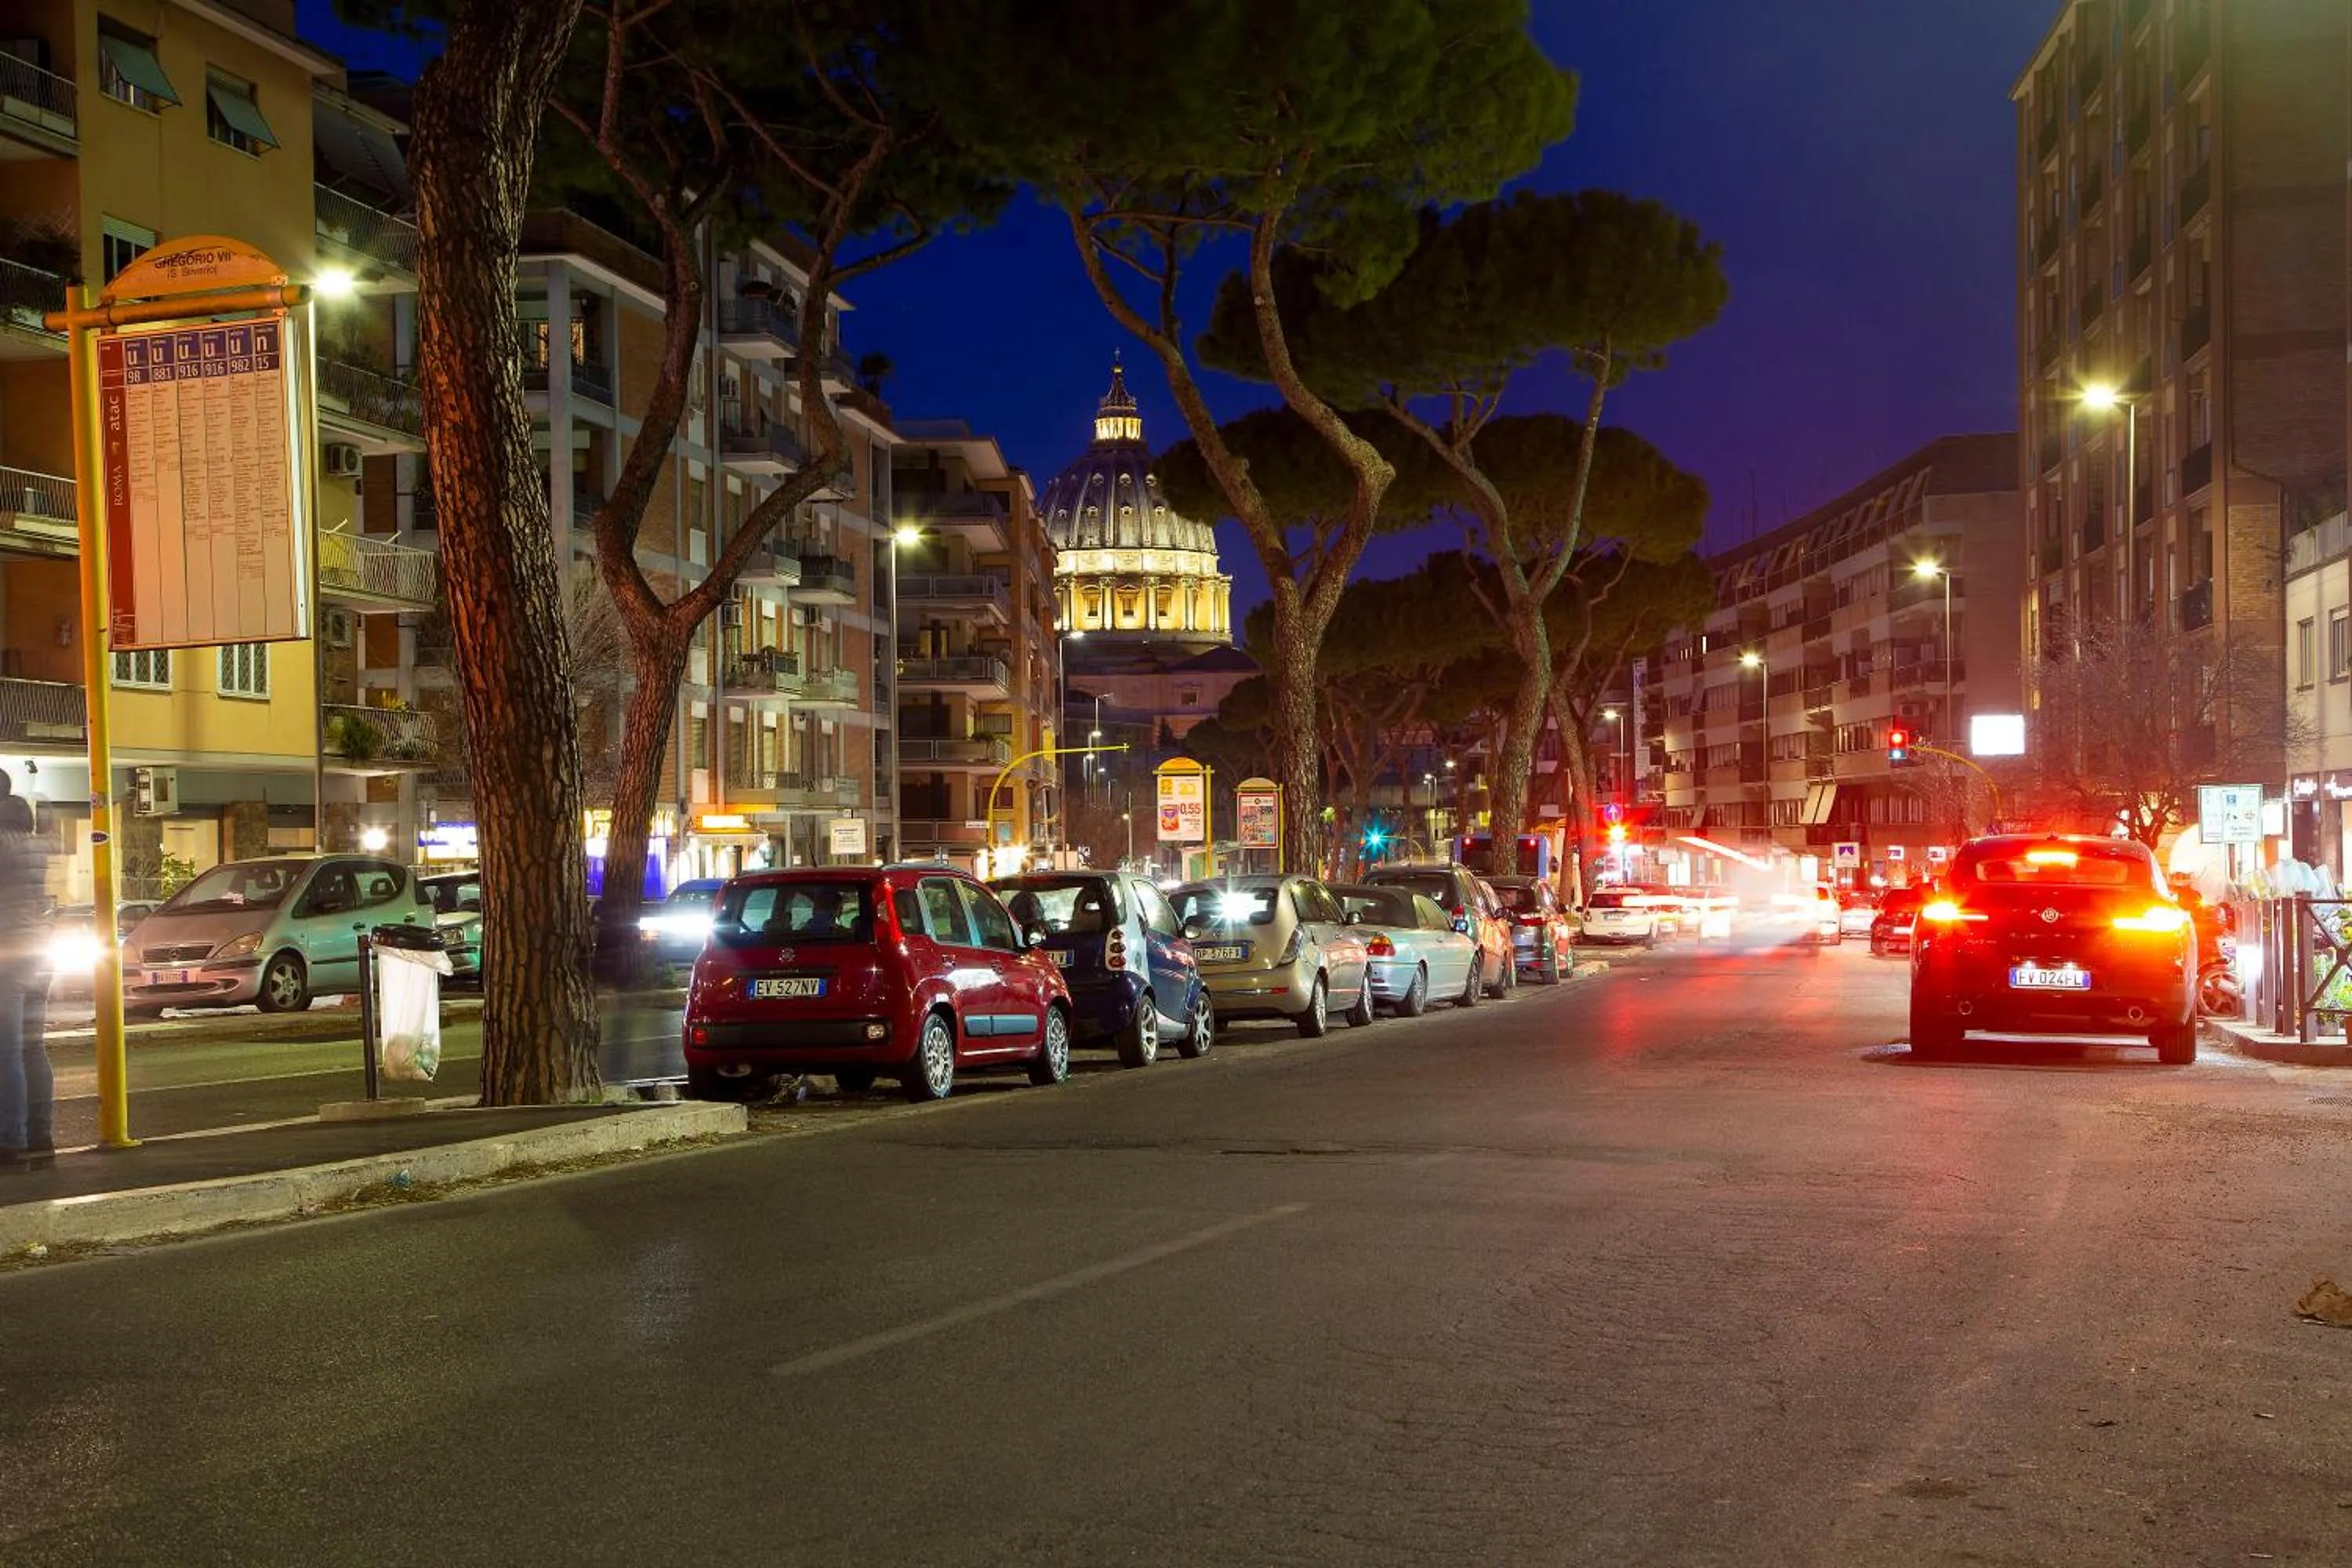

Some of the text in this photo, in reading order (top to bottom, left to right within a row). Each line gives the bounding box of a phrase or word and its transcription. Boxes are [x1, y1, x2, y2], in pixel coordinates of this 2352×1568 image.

[154, 251, 231, 269] GREGORIO VII
[179, 344, 189, 360] u
[205, 343, 215, 358] u
[230, 338, 240, 354] u
[256, 336, 267, 352] n
[128, 350, 137, 366] u
[153, 348, 163, 363] u
[256, 355, 270, 370] 15
[180, 363, 198, 378] 916
[205, 361, 224, 376] 916
[128, 371, 141, 383] 98
[109, 395, 121, 431] atac
[112, 465, 123, 506] ROMA
[1180, 802, 1202, 815] 0,55
[757, 979, 818, 995] EV 527NV
